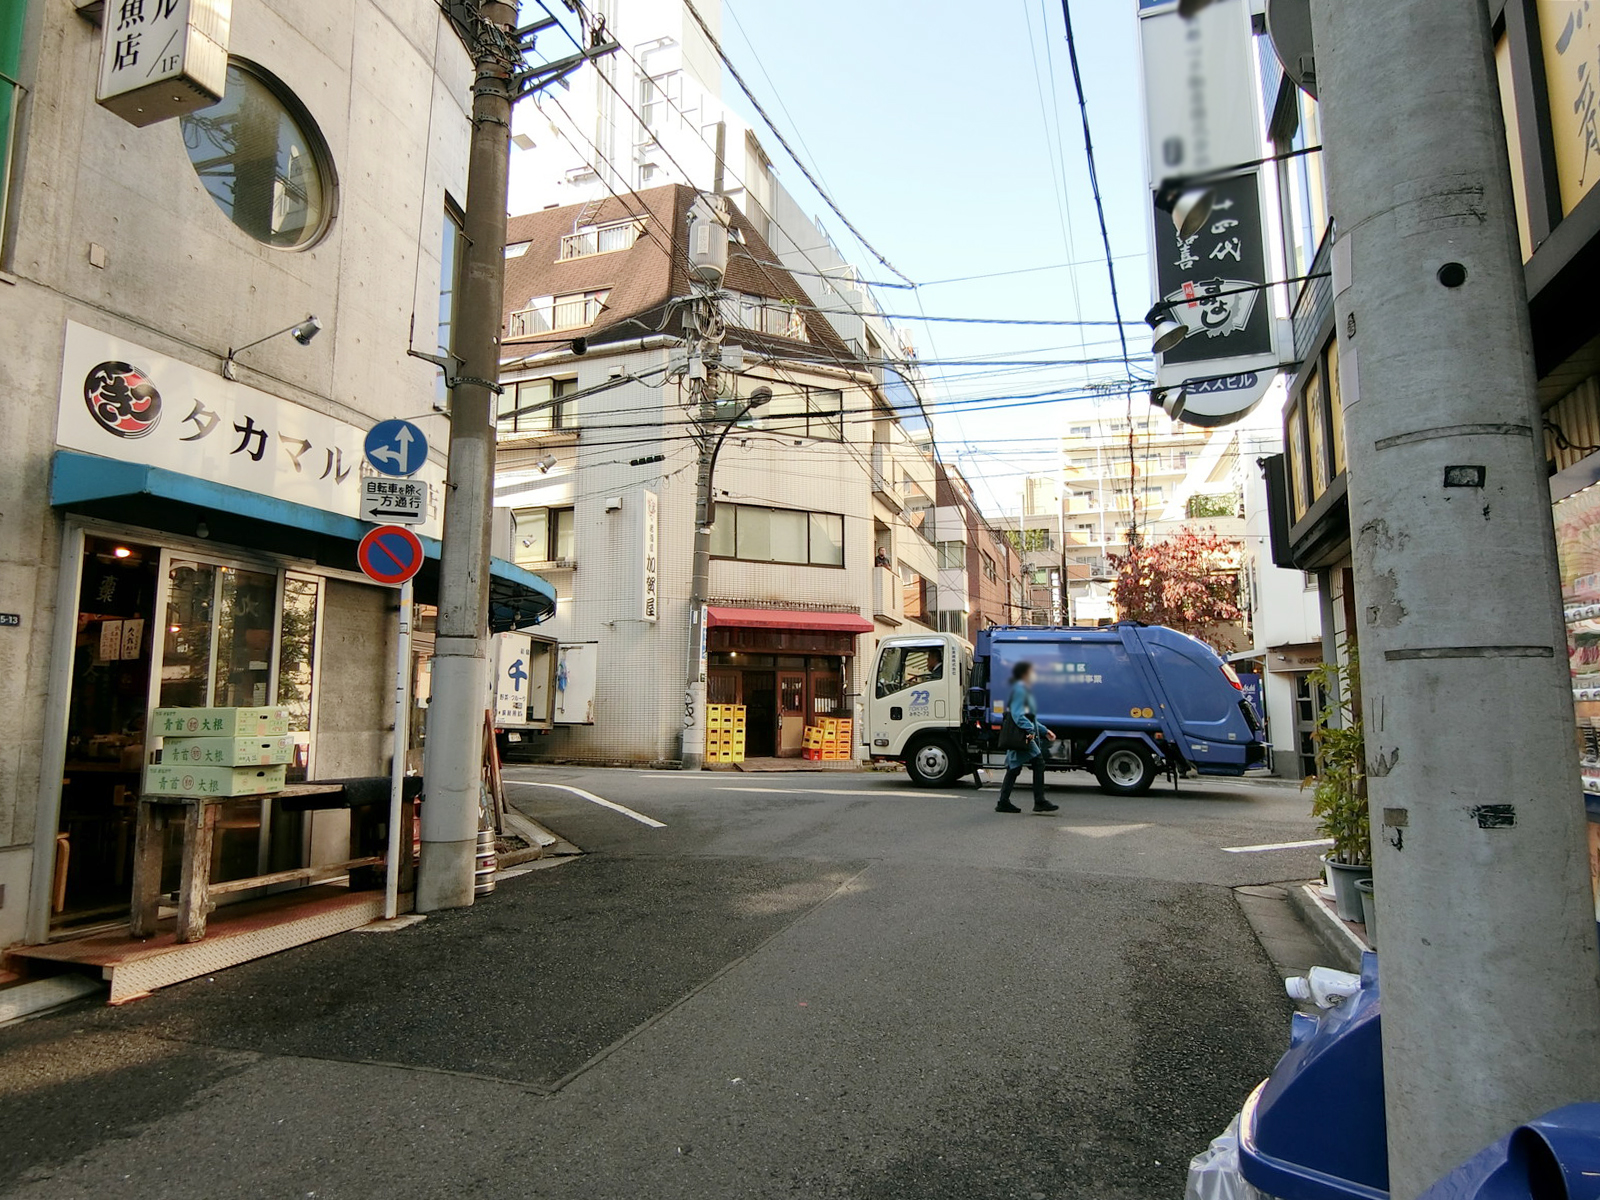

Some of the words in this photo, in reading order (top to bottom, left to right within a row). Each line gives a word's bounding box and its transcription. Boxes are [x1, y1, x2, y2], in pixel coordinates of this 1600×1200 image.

[366, 481, 422, 497] 自転車を除く
[366, 496, 422, 509] 一方通行
[909, 690, 930, 707] 23
